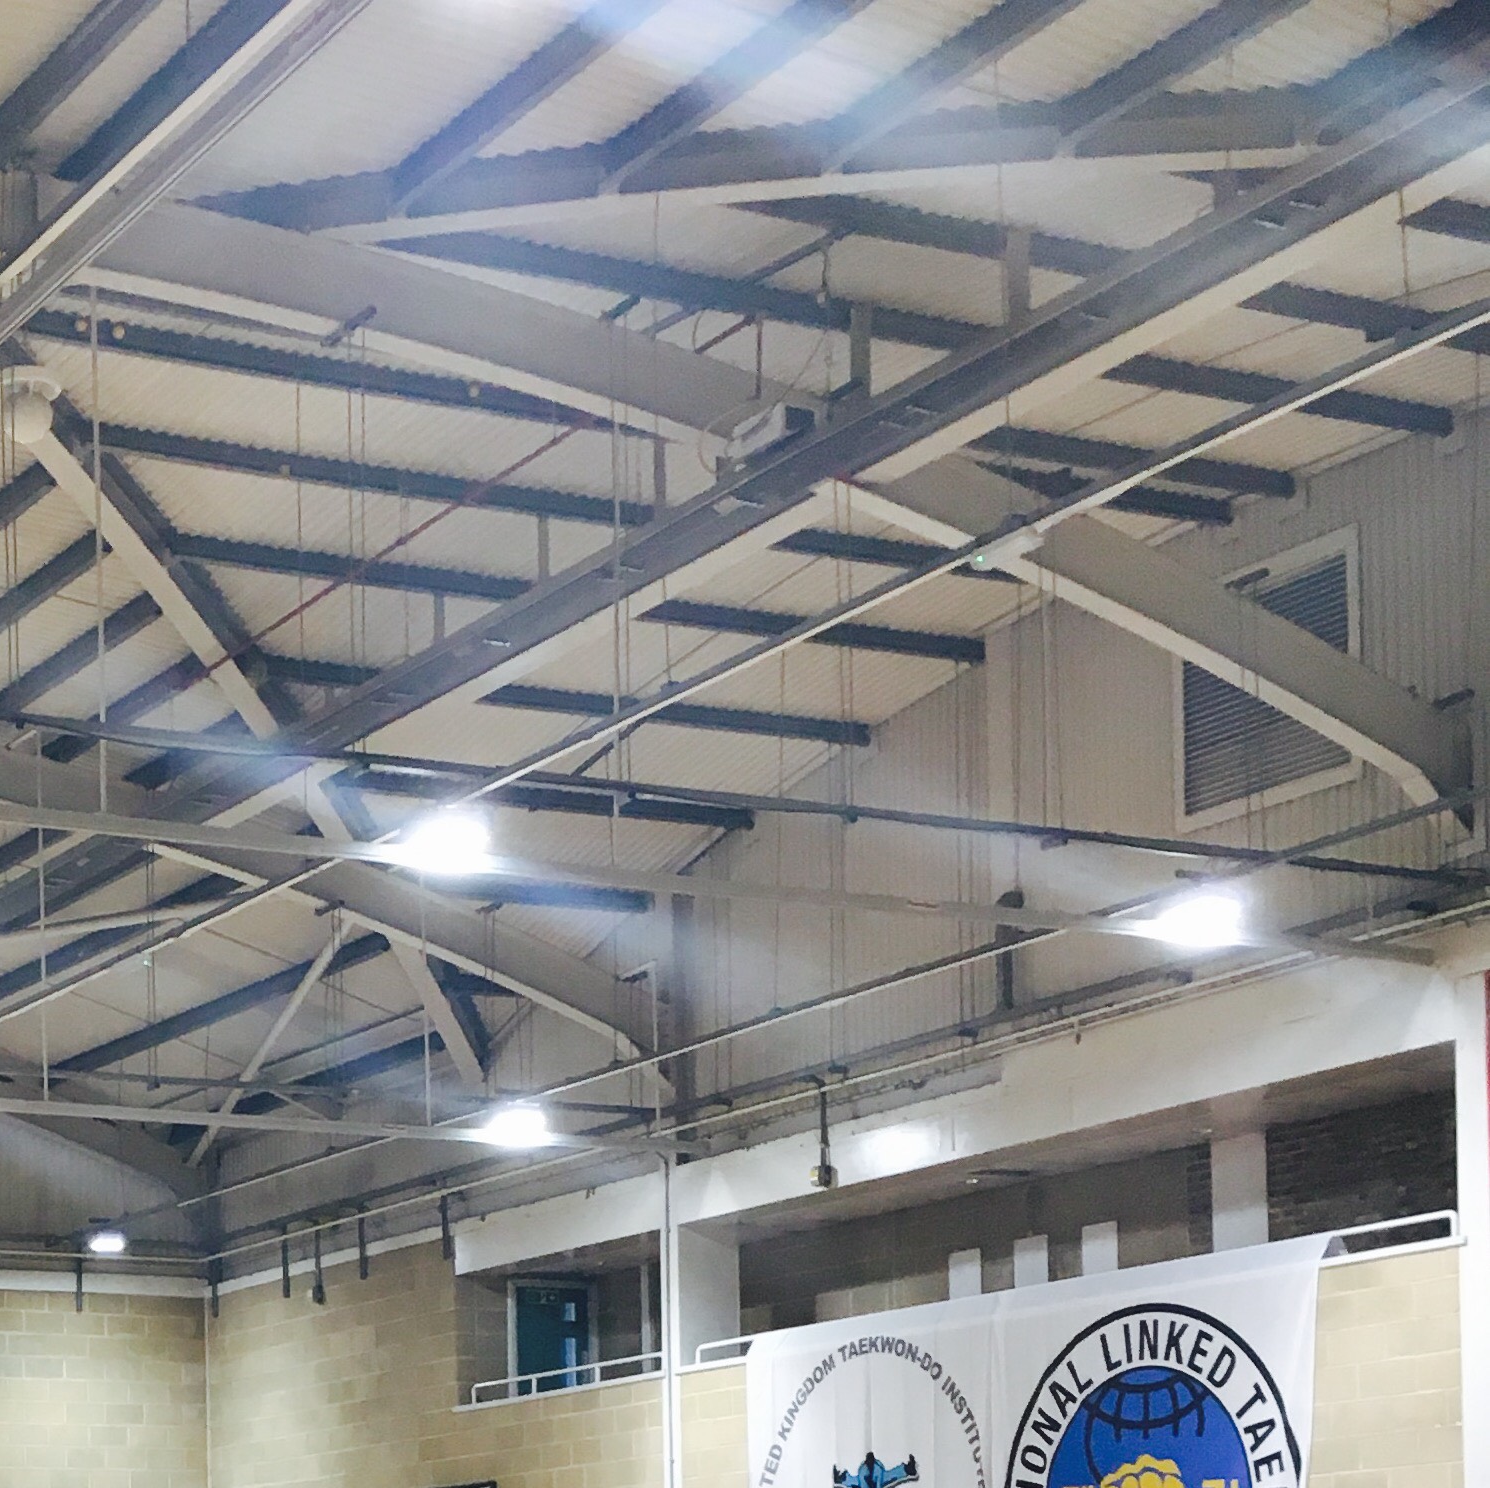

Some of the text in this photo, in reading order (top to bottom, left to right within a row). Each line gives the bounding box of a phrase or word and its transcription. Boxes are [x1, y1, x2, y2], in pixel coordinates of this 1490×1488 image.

[778, 1353, 836, 1442] KINGDOM
[838, 1335, 943, 1380] TAEKWON-DO
[1099, 1319, 1236, 1388] LINKED
